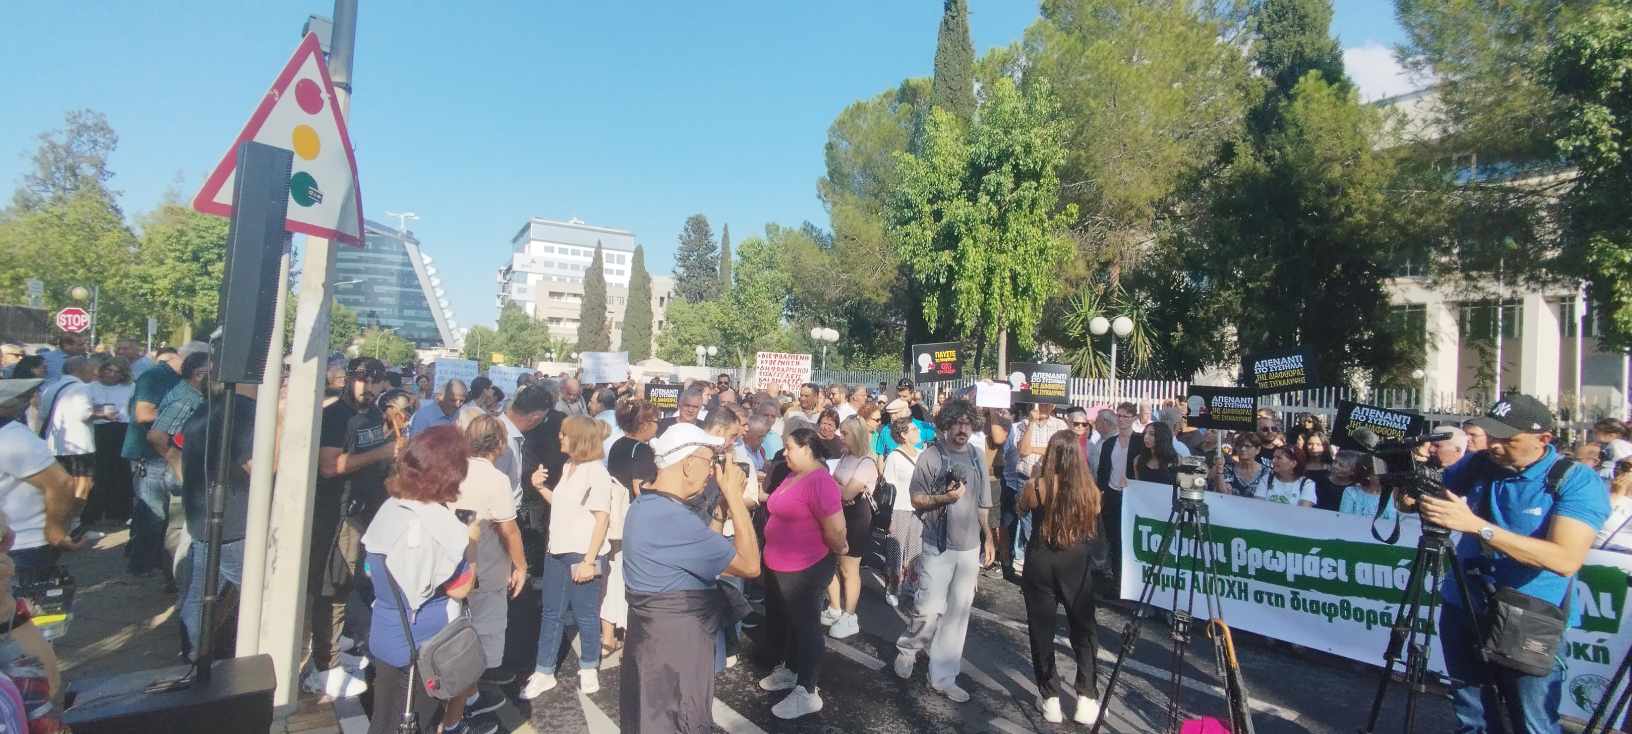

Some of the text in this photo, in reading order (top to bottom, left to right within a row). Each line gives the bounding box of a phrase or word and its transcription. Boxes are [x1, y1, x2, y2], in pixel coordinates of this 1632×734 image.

[60, 314, 87, 326] STOP
[1254, 355, 1303, 369] ΑΠΕΝΑΝΤΙ
[1269, 362, 1303, 372] ΣΥΣΤΗΜΑ
[1031, 372, 1067, 380] ΑΠΕΝΑΝΤΙ
[1212, 395, 1253, 404] ΑΠΕΝΑΝΤΙ
[1351, 406, 1411, 424] ΑΠΕΝΑΝΤΙ
[1368, 415, 1407, 431] ΣΥΣΤΗΜΑ
[1138, 525, 1162, 552] Το
[1231, 537, 1348, 582] βρωμάει
[1355, 559, 1412, 590] από
[1253, 590, 1286, 609] στη
[1290, 590, 1393, 630] διαφθορά
